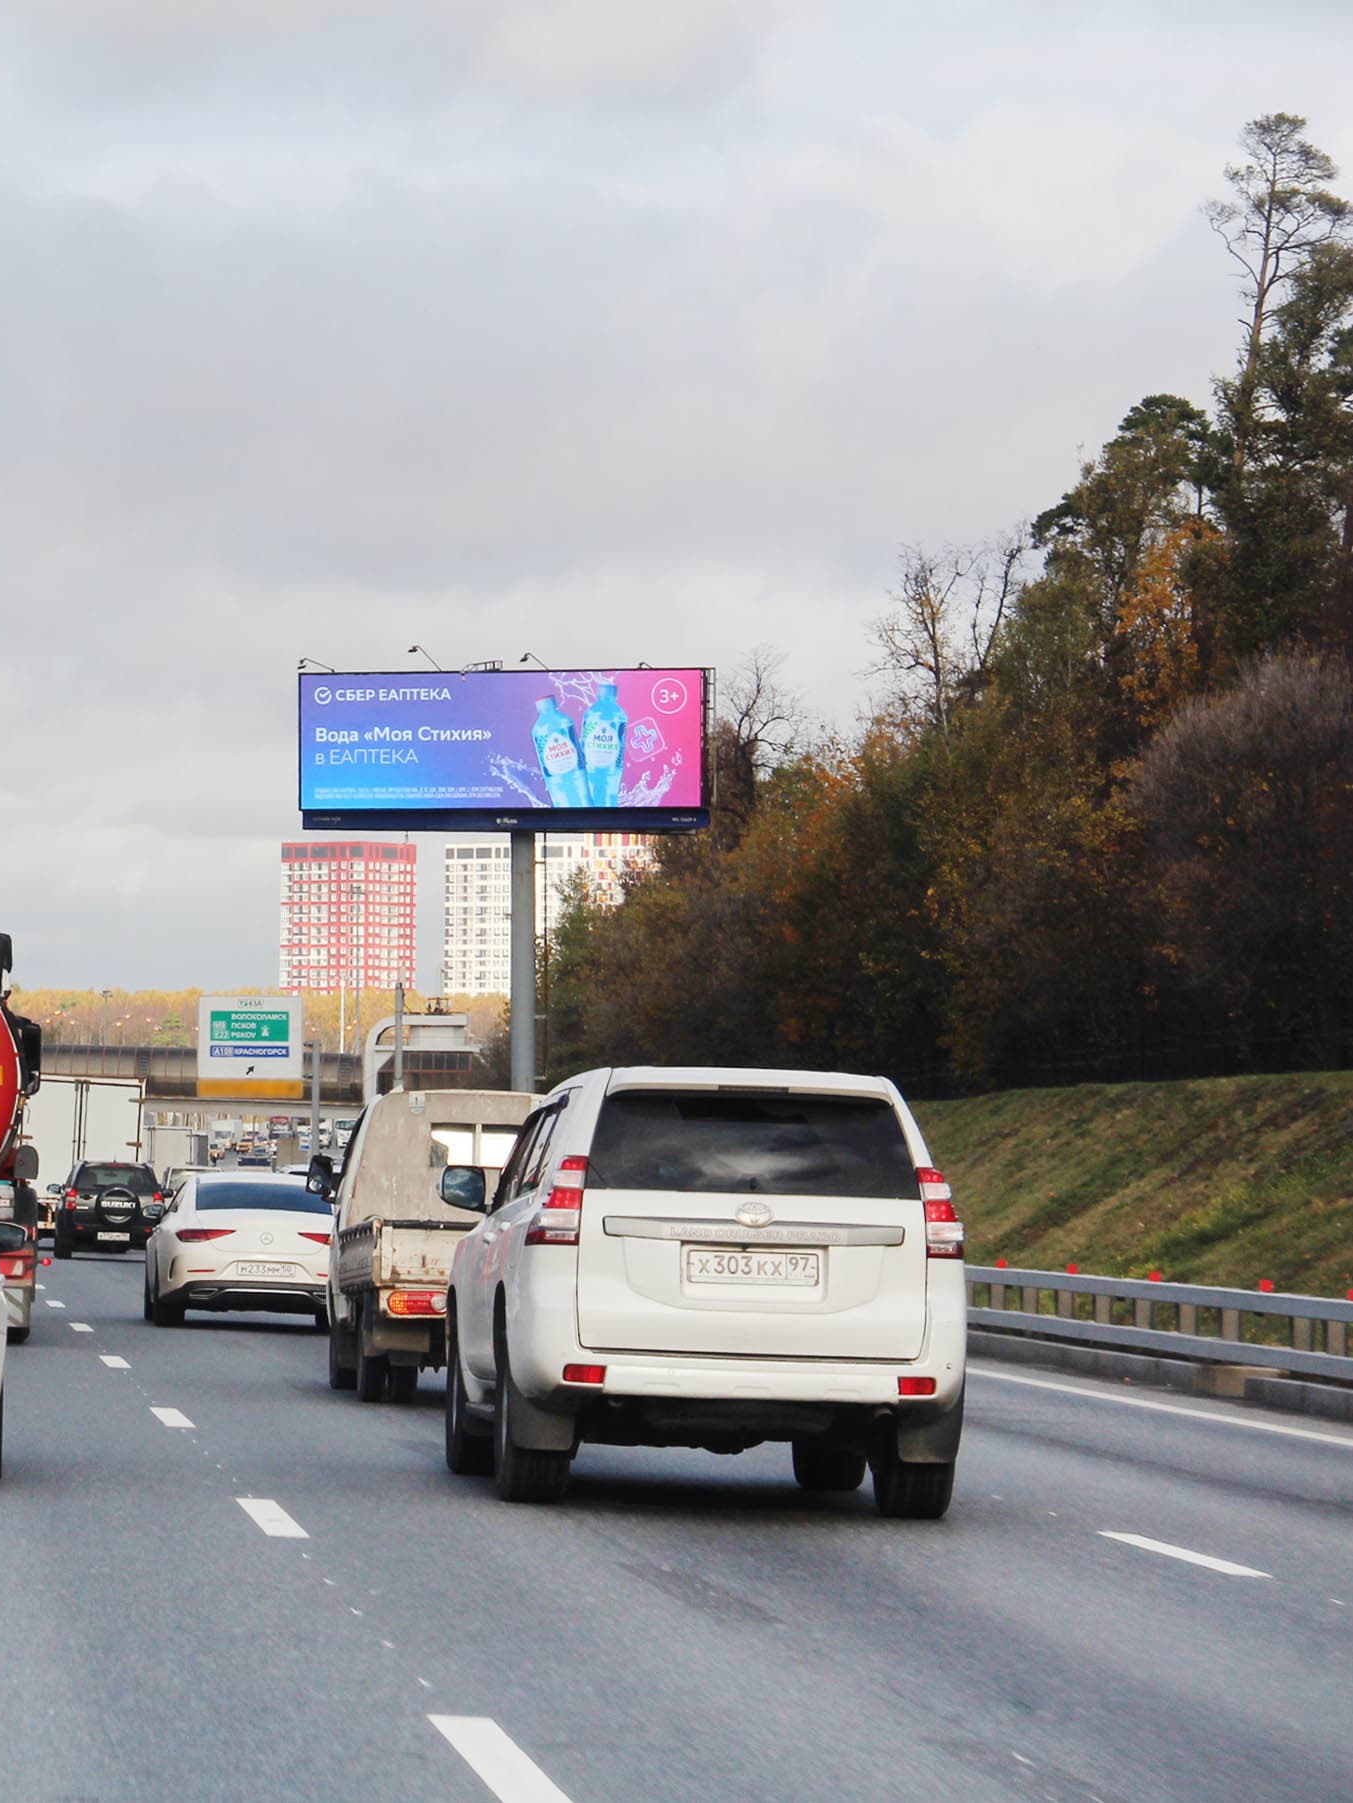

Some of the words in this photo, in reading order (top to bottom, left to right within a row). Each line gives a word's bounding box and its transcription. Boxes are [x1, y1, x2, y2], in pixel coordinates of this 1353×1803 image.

[335, 689, 376, 701] СБЕР
[379, 688, 452, 701] ЕАПТЕКА
[659, 689, 679, 704] 3+
[315, 727, 359, 744] Вода
[364, 726, 413, 742] «Моя
[417, 726, 492, 742] Стихия»
[315, 753, 325, 765] в
[330, 749, 419, 765] ЕАПТЕКА
[101, 1200, 136, 1208] SUZUKI
